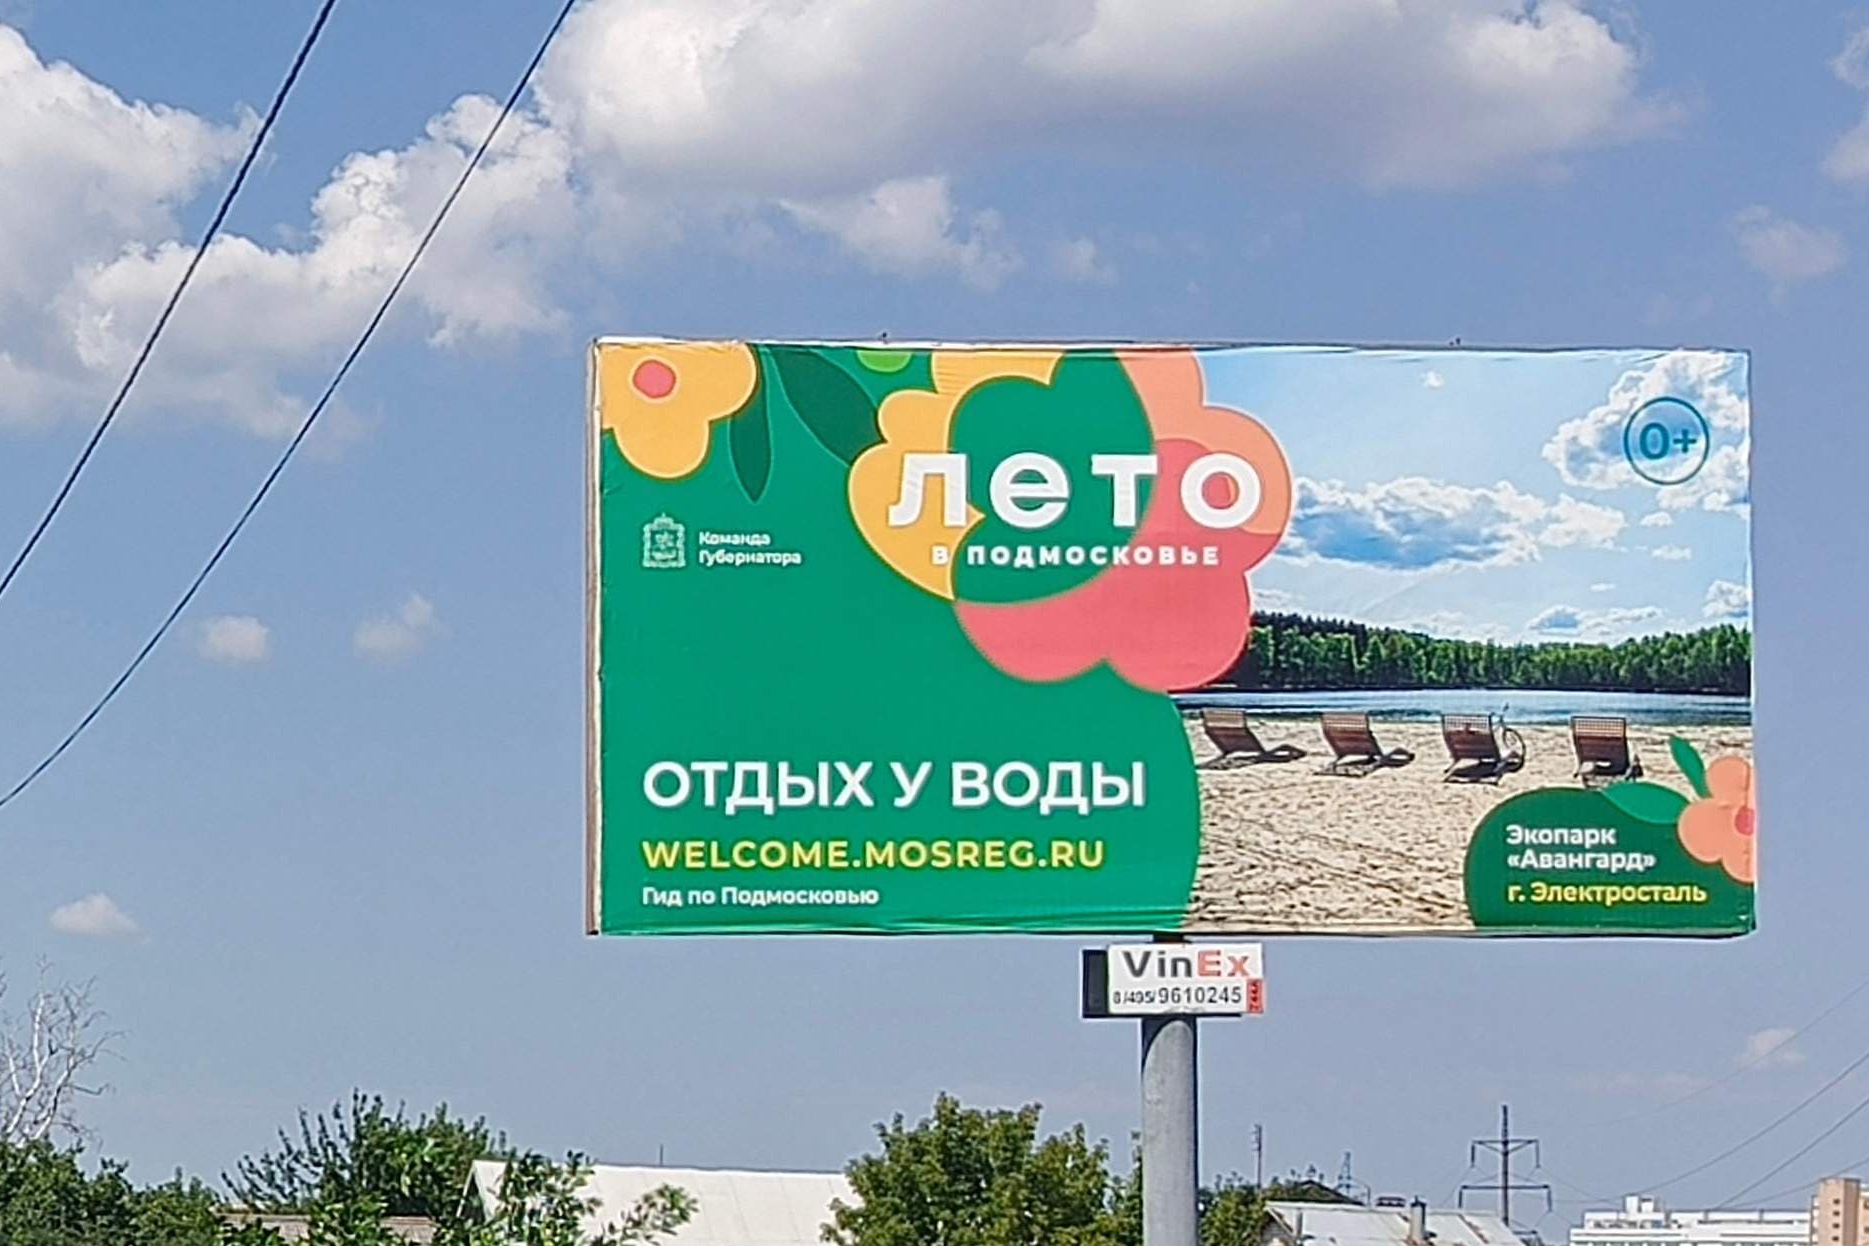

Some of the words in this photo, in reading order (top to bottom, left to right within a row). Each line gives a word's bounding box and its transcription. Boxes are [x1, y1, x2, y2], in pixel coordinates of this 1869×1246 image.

[1638, 421, 1697, 461] 0+
[698, 531, 771, 546] Команда
[698, 549, 802, 567] Губернатора
[931, 546, 950, 566] В
[966, 545, 1221, 569] ПОДМОСКОВЬЕ
[642, 761, 875, 816] ОТДЫХ
[890, 761, 932, 808] У
[951, 761, 1147, 816] ВОДЫ
[1505, 824, 1617, 848] Экопарк
[642, 840, 1105, 869] WELCOME.MOSREG.RU
[1506, 849, 1657, 873] «Авангард»
[642, 886, 683, 907] Гид
[687, 889, 716, 905] по
[721, 886, 880, 907] Подмосковью
[1507, 884, 1526, 902] г.
[1530, 881, 1708, 906] Электросталь
[1122, 950, 1250, 978] VinEx
